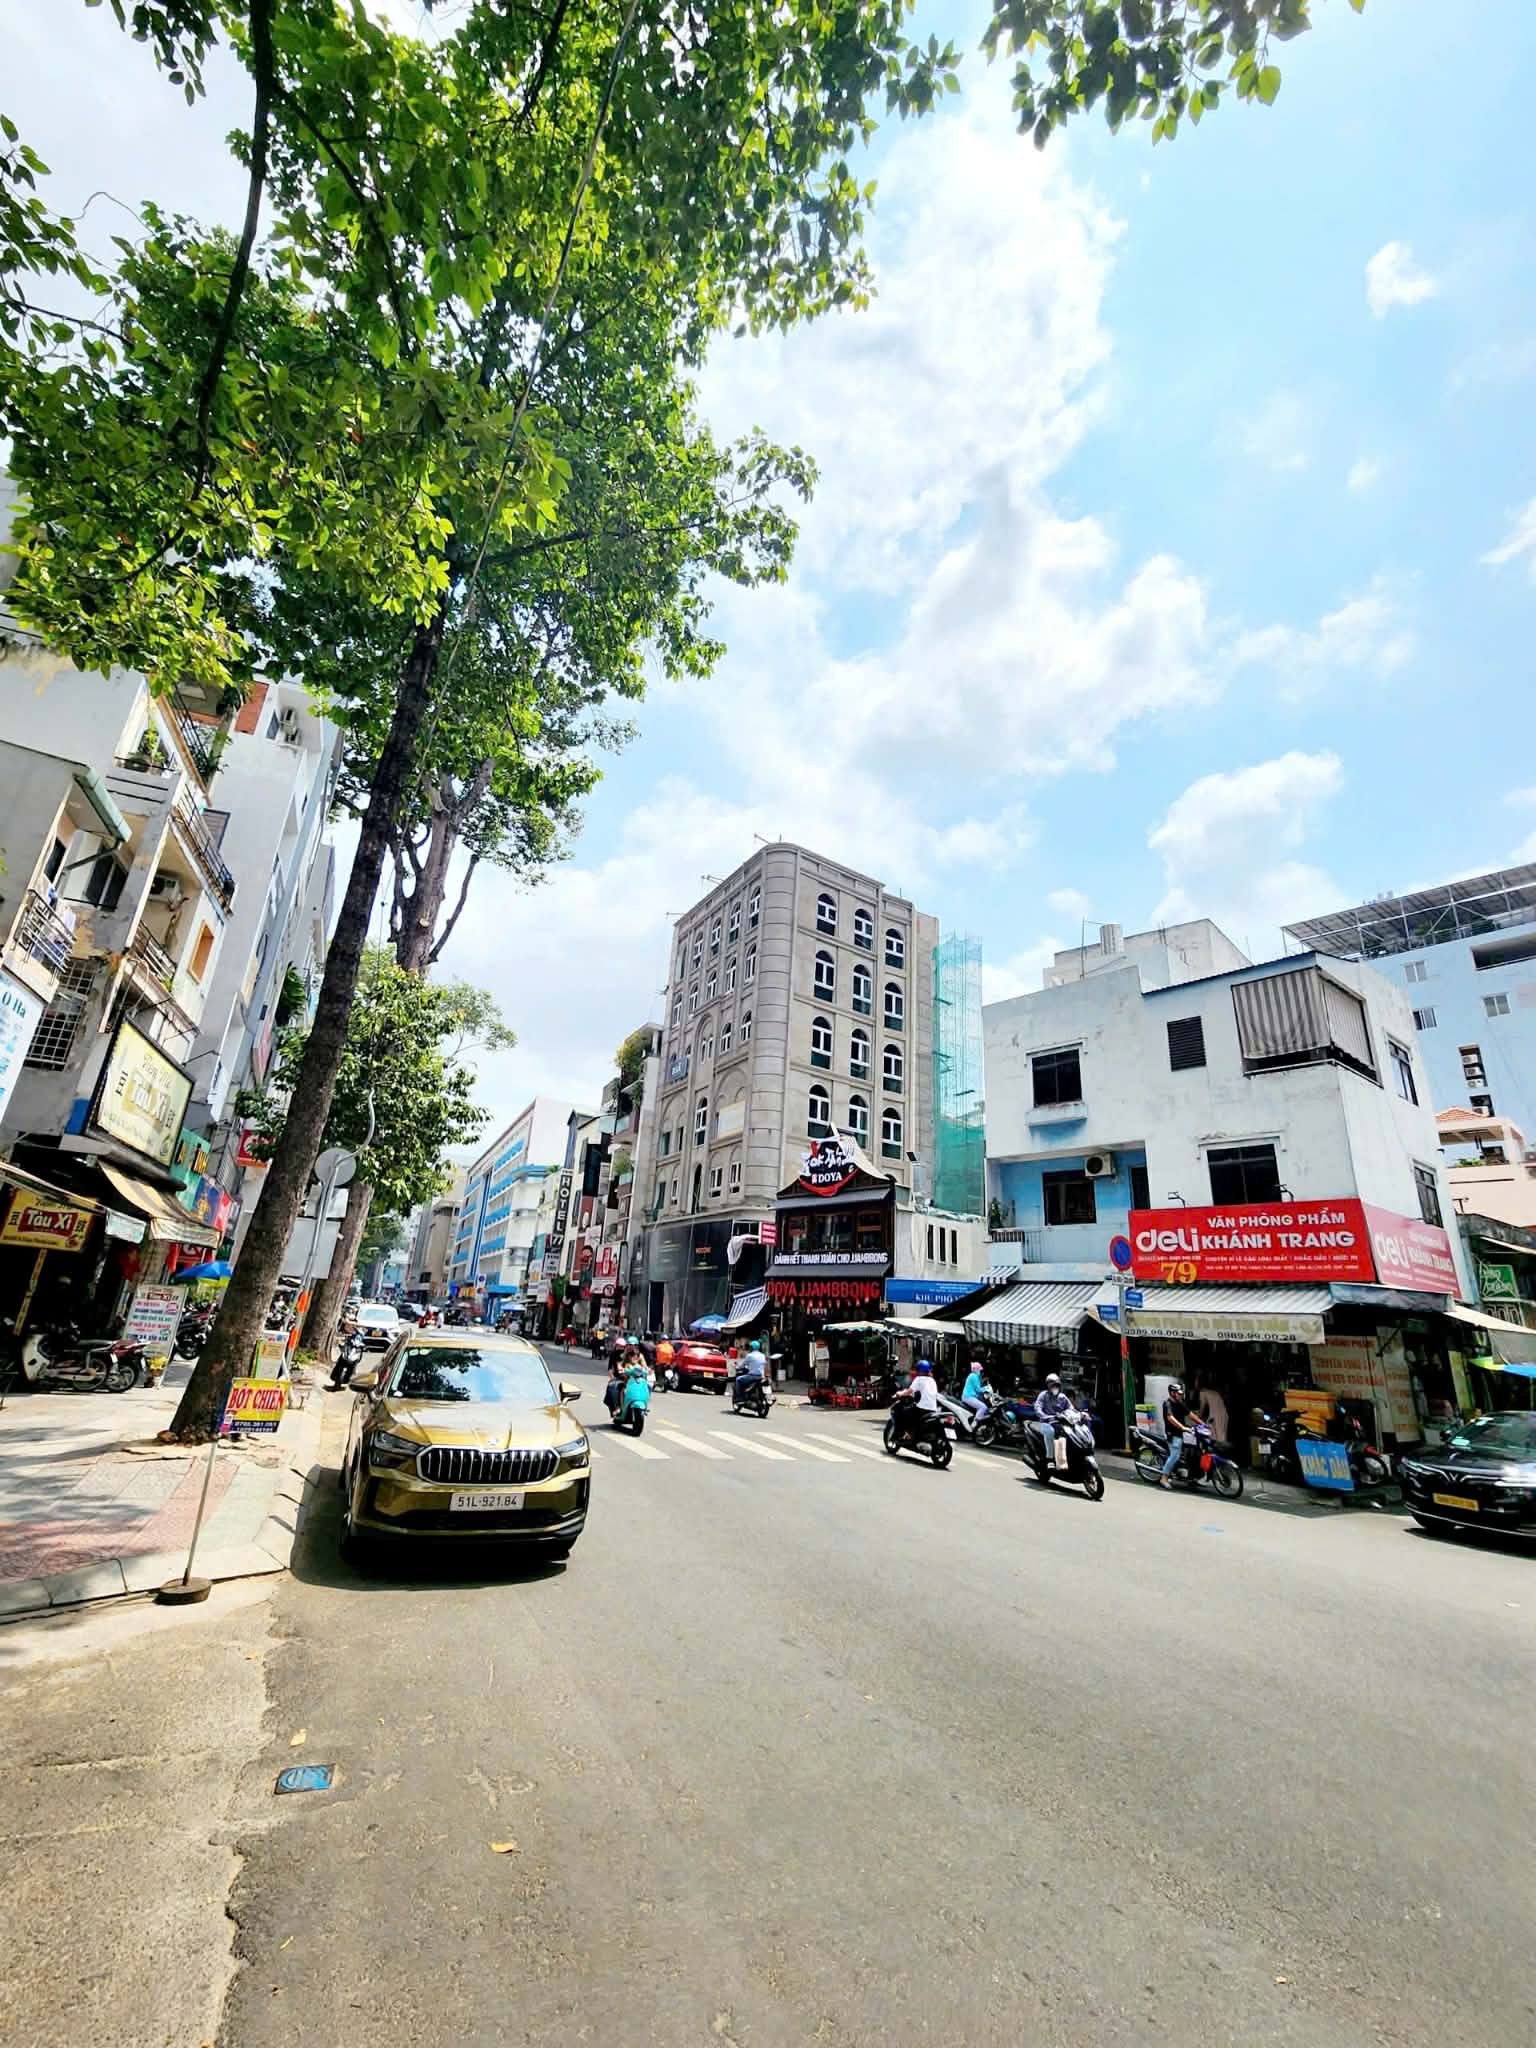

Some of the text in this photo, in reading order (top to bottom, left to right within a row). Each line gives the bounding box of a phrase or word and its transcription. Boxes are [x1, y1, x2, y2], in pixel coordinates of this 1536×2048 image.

[818, 1171, 843, 1184] DOYA
[556, 1176, 571, 1232] HOTEL
[1207, 1207, 1345, 1229] VĂN PHÒNG PHẨM
[1136, 1228, 1200, 1252] deli
[1201, 1229, 1356, 1250] KHÁNH TRANG
[837, 1253, 850, 1264] CHO
[1160, 1262, 1198, 1285] 79
[767, 1279, 881, 1298] DOYA JJAMBBONG
[457, 1495, 518, 1507] 51L-921.84
